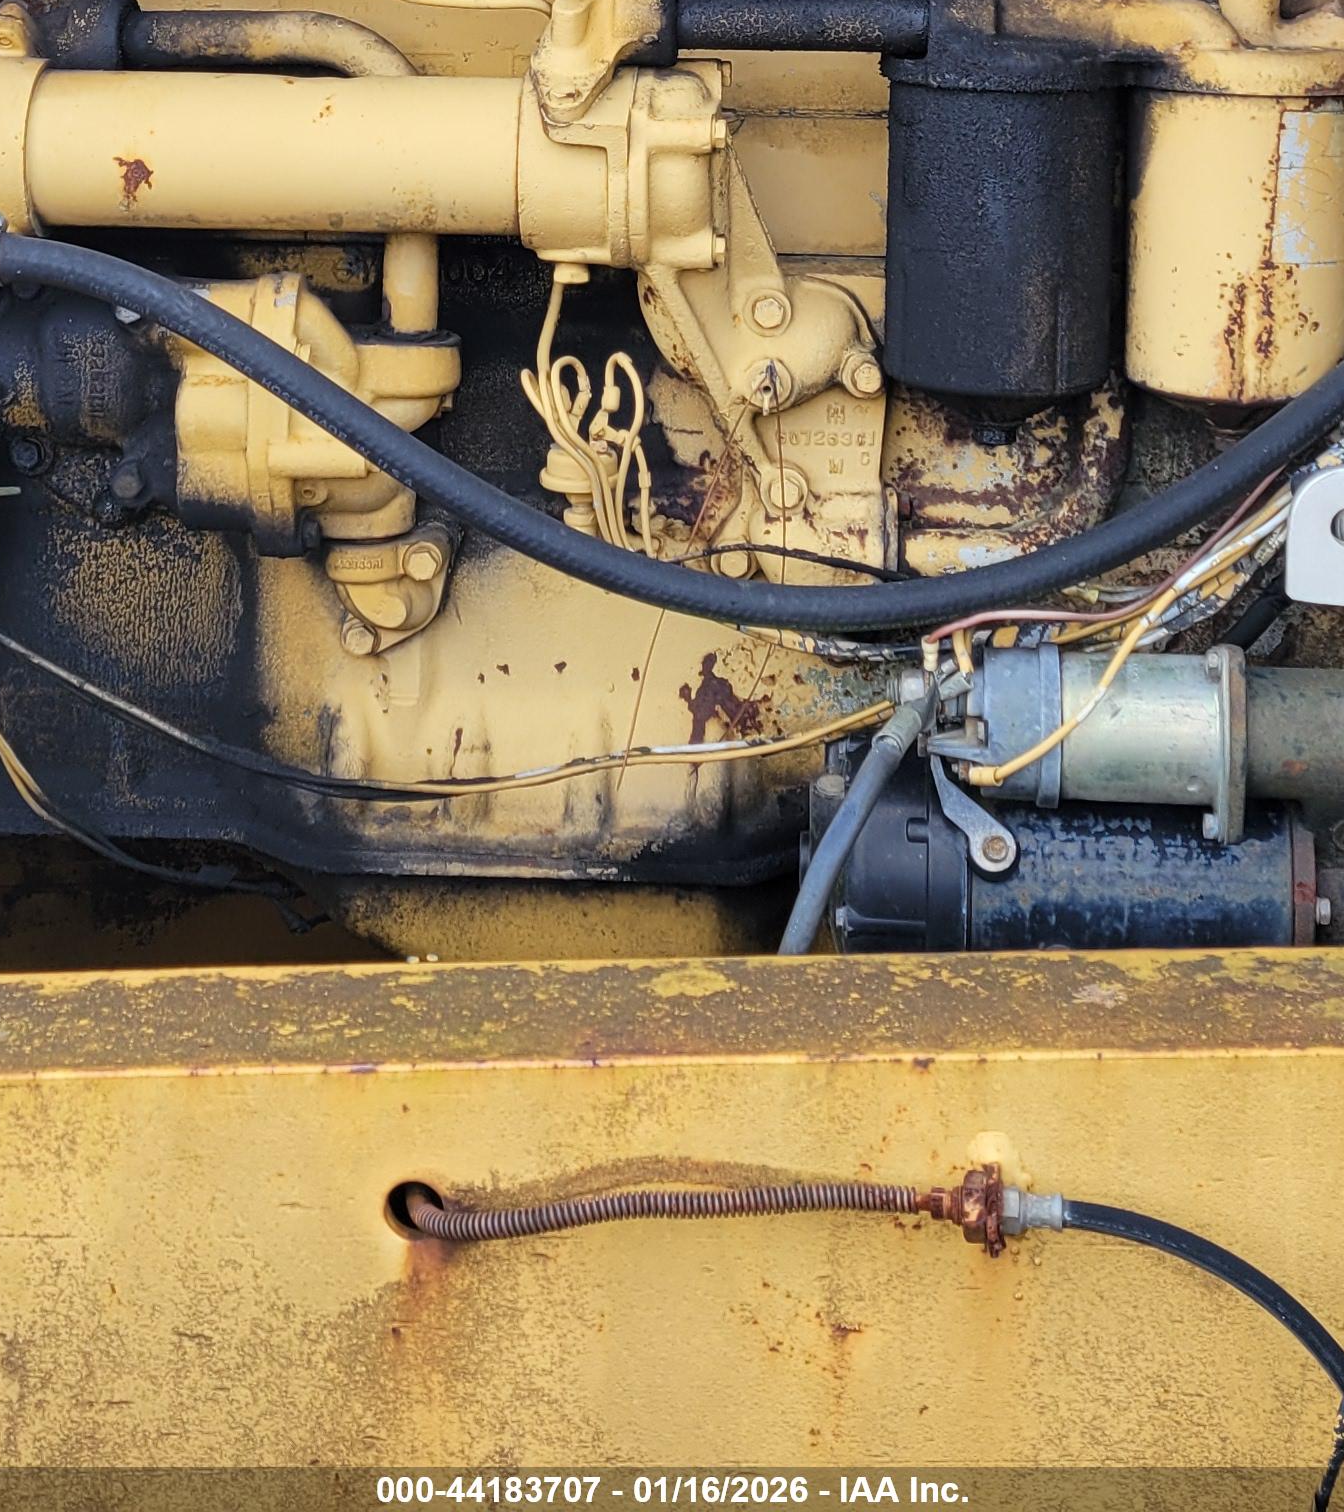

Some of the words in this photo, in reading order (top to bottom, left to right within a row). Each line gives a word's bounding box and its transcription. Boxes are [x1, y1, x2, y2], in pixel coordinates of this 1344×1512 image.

[259, 376, 301, 409] HOSE
[306, 409, 348, 441] MADE
[353, 442, 371, 458] IN
